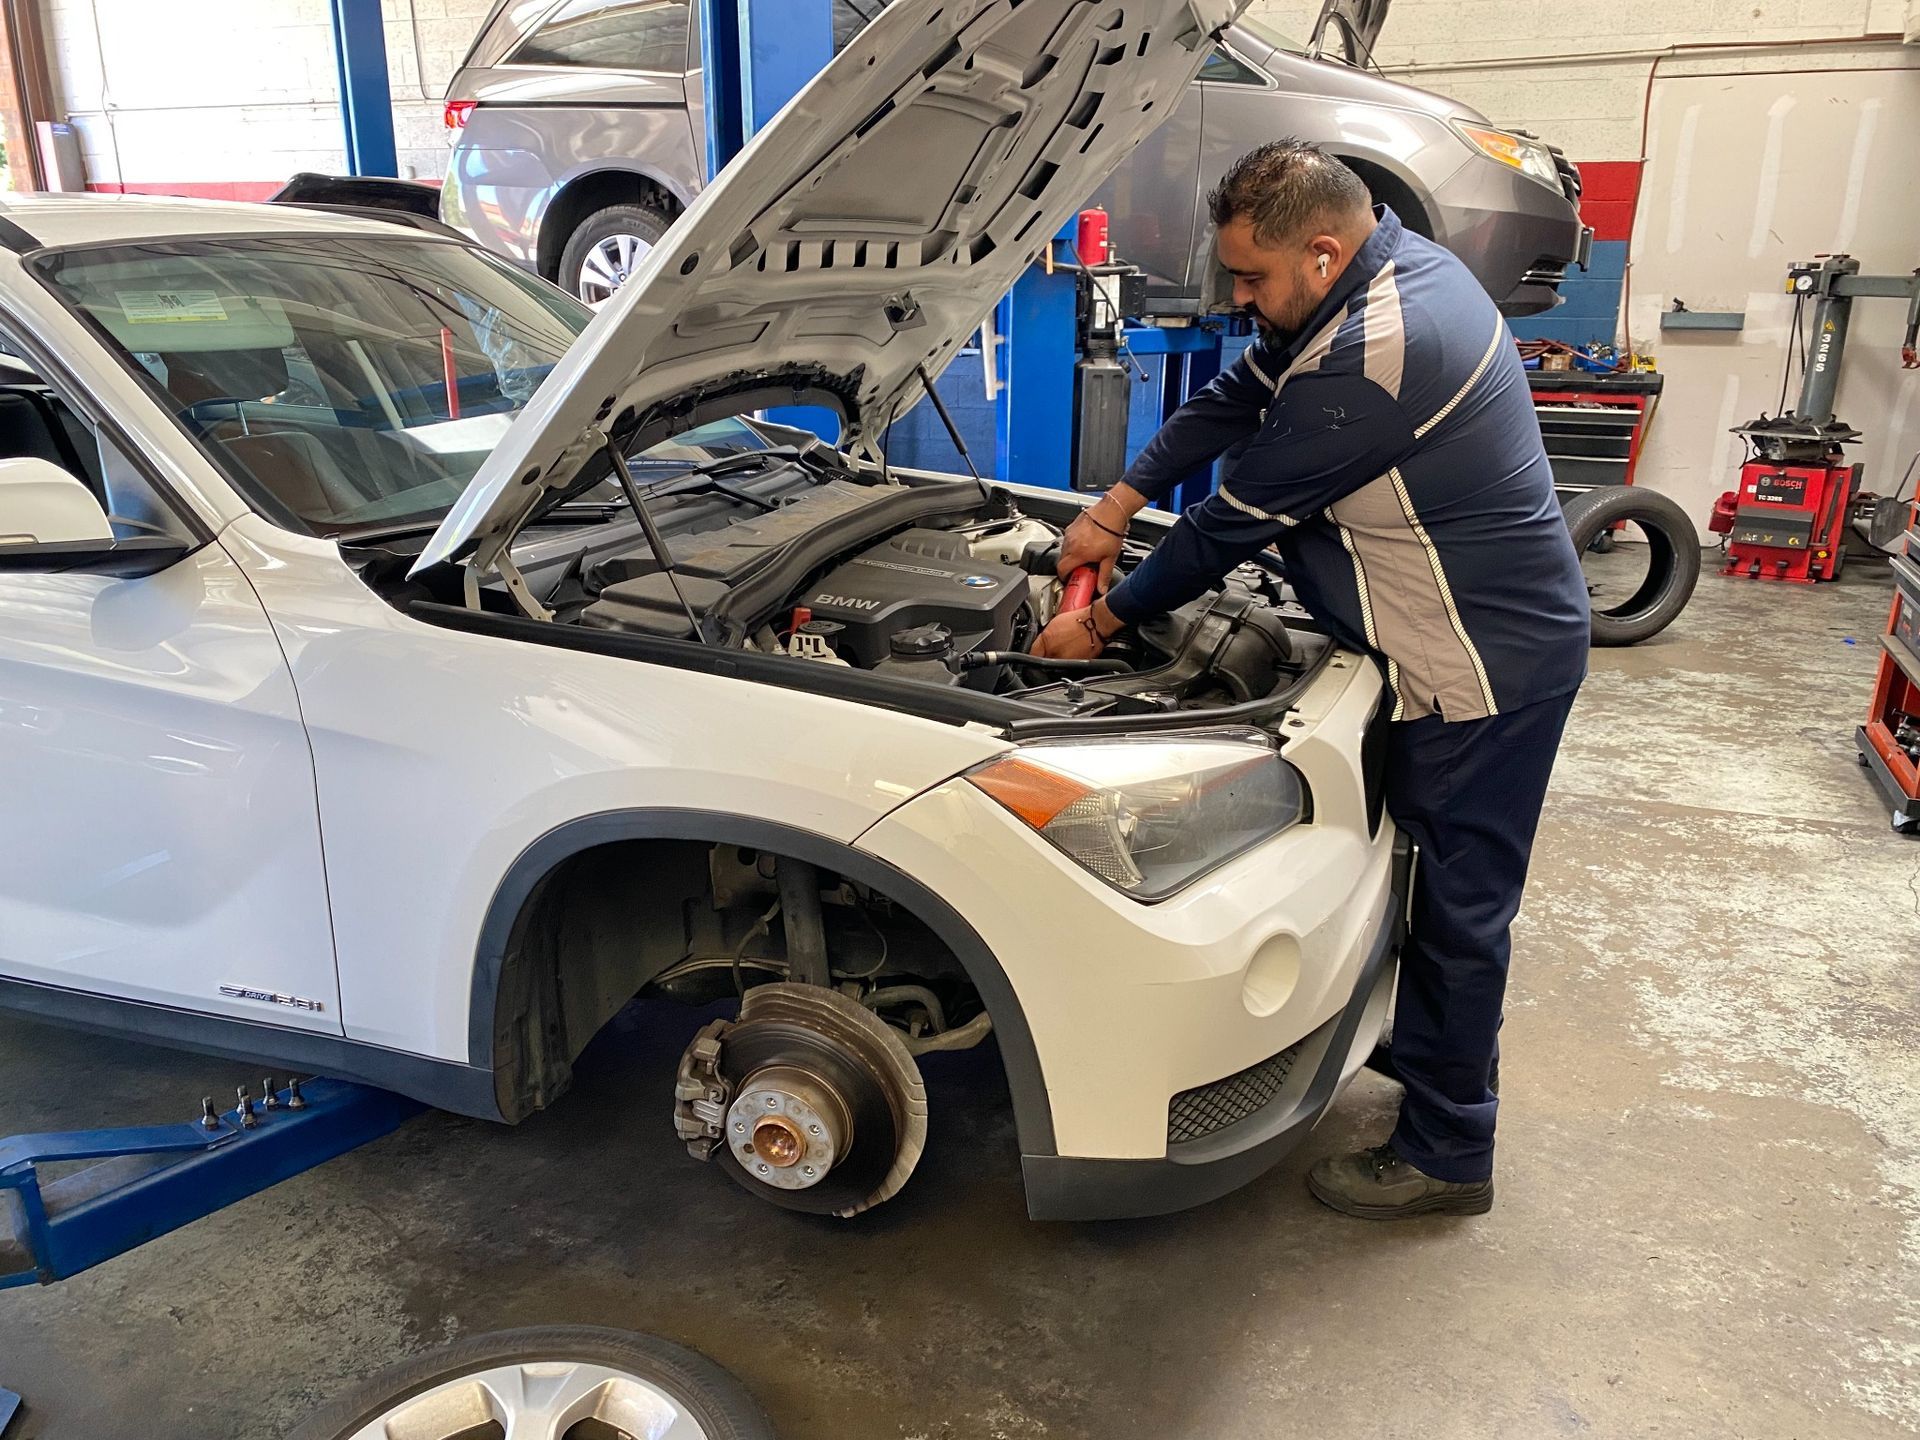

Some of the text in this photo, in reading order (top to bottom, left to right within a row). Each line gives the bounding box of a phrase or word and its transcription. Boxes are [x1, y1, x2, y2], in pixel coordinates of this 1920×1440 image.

[1815, 333, 1831, 372] 326S
[1773, 479, 1803, 488] BOSCH
[814, 594, 881, 610] BMW
